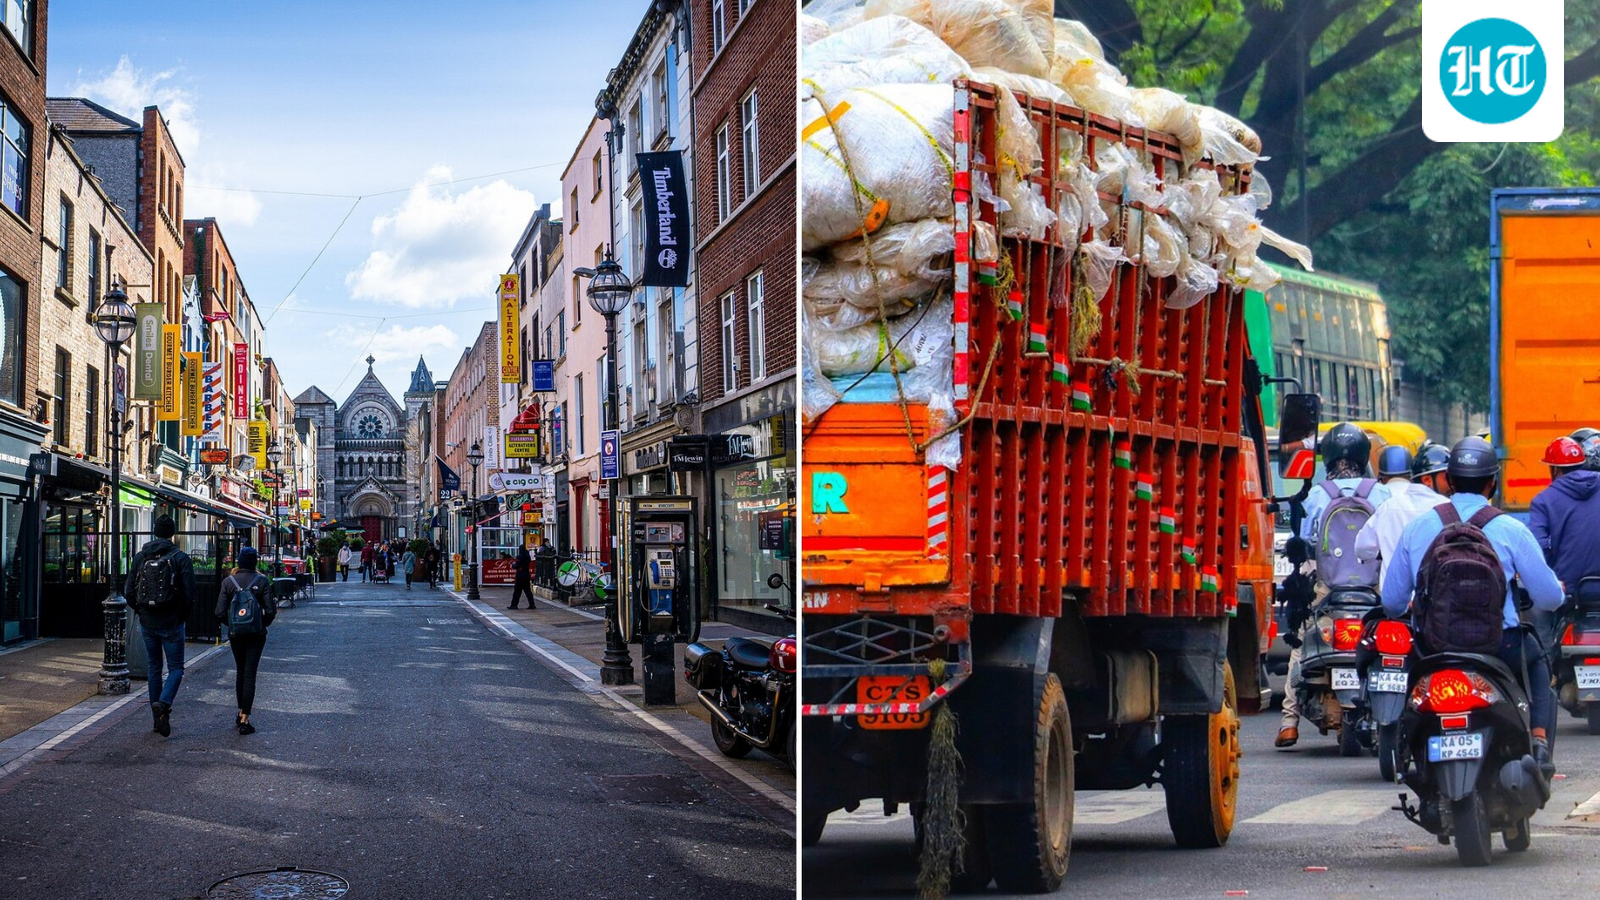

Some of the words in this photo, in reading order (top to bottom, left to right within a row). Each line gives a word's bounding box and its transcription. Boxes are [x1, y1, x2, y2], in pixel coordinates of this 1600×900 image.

[653, 166, 678, 245] Timberland
[145, 319, 154, 347] Smiles
[506, 302, 515, 366] ALTERATION
[144, 352, 154, 382] Dental
[165, 362, 173, 386] BURGER
[189, 358, 197, 383] GOURMET
[189, 384, 197, 404] BURGER
[204, 375, 213, 431] BARBER
[189, 405, 197, 429] KITCHEN
[440, 489, 450, 499] 22
[512, 477, 527, 487] cig
[811, 472, 849, 513] R
[1379, 673, 1391, 682] KA
[1393, 673, 1405, 682] 46
[866, 686, 921, 700] CTS
[1441, 737, 1455, 748] KA
[1458, 735, 1473, 746] 05
[1441, 750, 1453, 759] KP
[1456, 748, 1480, 757] 4545
